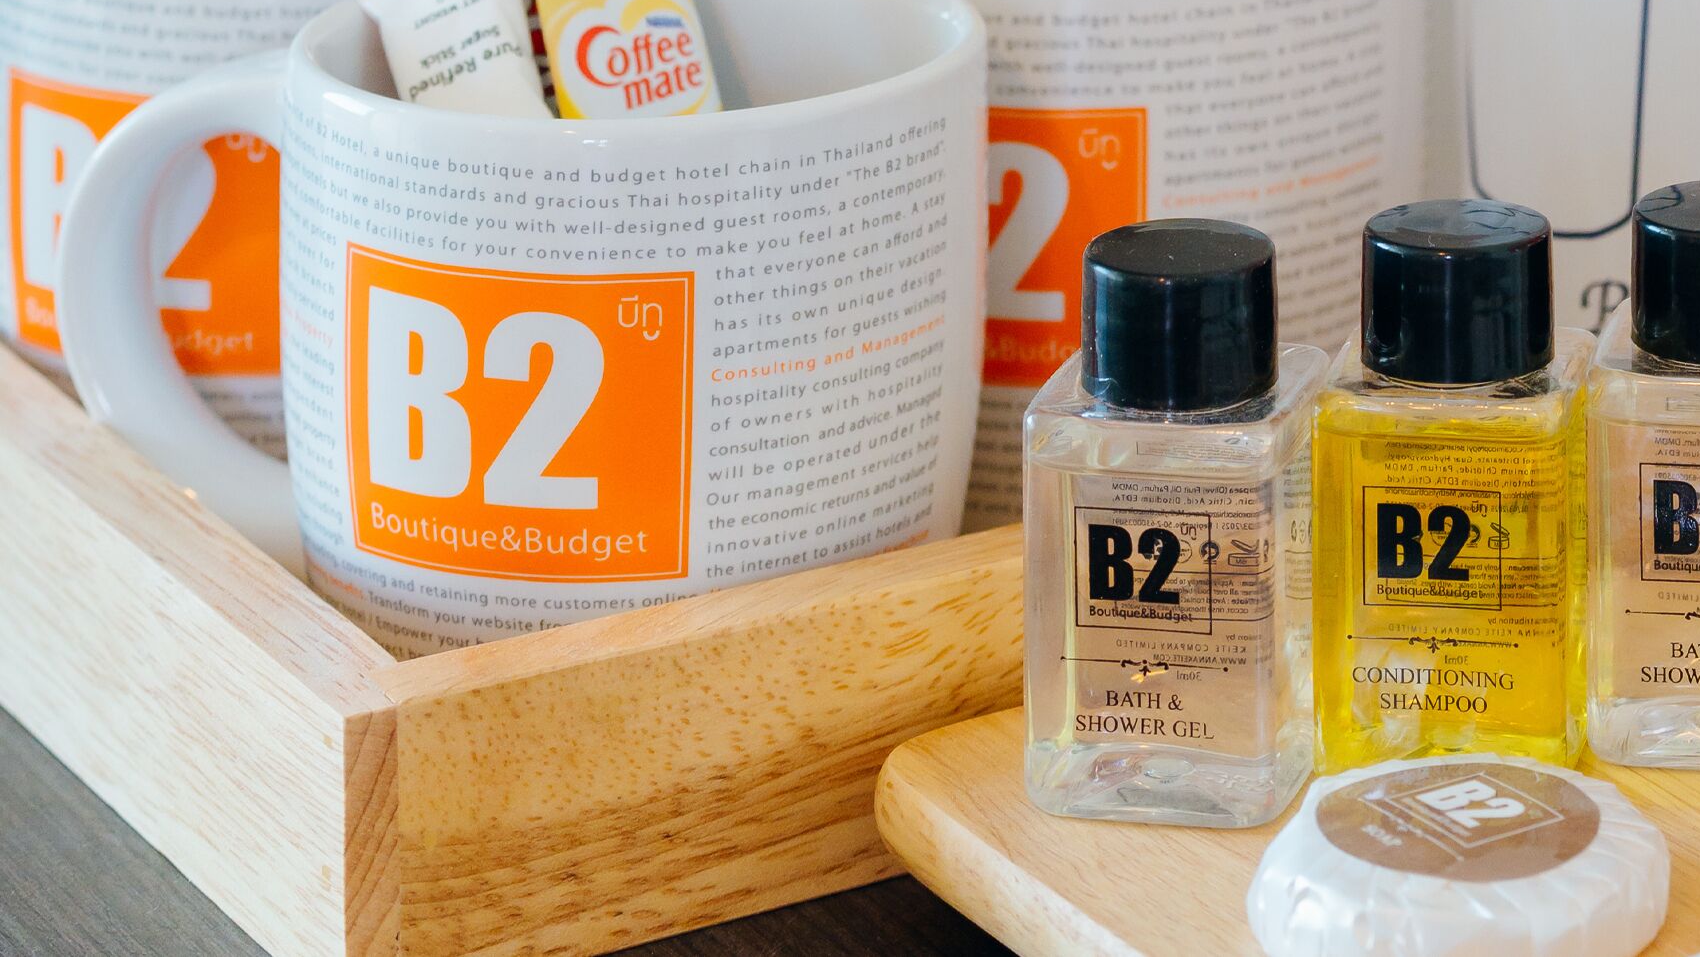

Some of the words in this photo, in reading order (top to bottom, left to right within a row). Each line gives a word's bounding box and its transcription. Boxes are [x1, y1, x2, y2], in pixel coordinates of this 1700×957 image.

[483, 41, 523, 60] Pure
[576, 25, 694, 88] Coffee
[409, 57, 477, 101] Refined
[623, 61, 703, 110] mate
[373, 146, 380, 158] a
[385, 149, 441, 173] unique
[447, 158, 536, 181] boutique
[543, 167, 581, 184] and
[590, 168, 667, 186] budget
[676, 163, 730, 181] hotel
[738, 157, 791, 176] chain
[799, 154, 816, 169] in
[823, 134, 894, 164] Thailand
[899, 116, 947, 144] offering
[320, 149, 400, 190] international
[404, 177, 487, 202] standards
[493, 189, 528, 206] and
[535, 194, 620, 211] gracious
[628, 193, 669, 208] Thai
[678, 178, 783, 208] hospitality
[790, 175, 841, 196] under
[885, 158, 902, 174] B2
[330, 177, 348, 199] but
[352, 190, 369, 206] we
[373, 197, 401, 216] also
[406, 205, 469, 228] provide
[475, 216, 507, 235] you
[515, 218, 556, 235] with
[564, 216, 706, 239] well-designed
[713, 212, 766, 233] guest
[773, 203, 832, 224] rooms,
[838, 200, 847, 212] a
[365, 219, 434, 249] facilities
[442, 236, 467, 253] for
[474, 241, 517, 258] your
[526, 245, 657, 261] convenience
[666, 246, 686, 260] to
[696, 241, 749, 258] make
[756, 236, 791, 256] you
[798, 226, 832, 244] feel
[839, 222, 855, 237] at
[862, 210, 906, 232] home.
[987, 141, 1069, 322] 2
[715, 265, 755, 281] that
[764, 253, 847, 275] everyone
[852, 242, 879, 259] can
[714, 288, 765, 307] other
[772, 281, 828, 303] things
[834, 275, 852, 289] on
[860, 263, 894, 284] their
[618, 295, 663, 341] บีทู
[714, 316, 749, 332] has
[758, 313, 782, 328] its
[792, 306, 829, 322] own
[837, 288, 895, 314] unique
[711, 355, 817, 383] Consulting
[823, 347, 855, 366] and
[861, 315, 945, 355] Management
[712, 330, 818, 359] apartments
[824, 326, 848, 341] for
[367, 285, 605, 510] B2
[710, 383, 807, 408] hospitality
[812, 363, 891, 394] consulting
[741, 408, 813, 430] owners
[822, 395, 860, 416] with
[708, 465, 744, 482] will
[752, 459, 775, 477] be
[783, 443, 861, 473] operated
[709, 432, 810, 458] consultation
[706, 492, 740, 507] Our
[747, 468, 856, 503] management
[371, 502, 648, 561] Boutique&Budget
[707, 528, 808, 554] innovative
[815, 512, 867, 536] online
[741, 502, 817, 526] economic
[740, 550, 808, 575] internet
[1377, 503, 1471, 581] B2
[1088, 524, 1181, 604] B2
[419, 582, 489, 608] retaining
[495, 595, 537, 610] more
[544, 596, 635, 611] customers
[1377, 584, 1483, 600] Boutique&Budget
[434, 607, 466, 625] your
[471, 613, 533, 633] website
[1089, 605, 1193, 624] Boutique&Budget
[1352, 666, 1514, 691] CONDITIONING
[1106, 690, 1160, 710] BATH
[1168, 695, 1183, 711] &
[1380, 693, 1488, 714] SHAMPOO
[1075, 715, 1166, 737] SHOWER
[1173, 720, 1215, 740] GEL
[1415, 779, 1526, 829] B2
